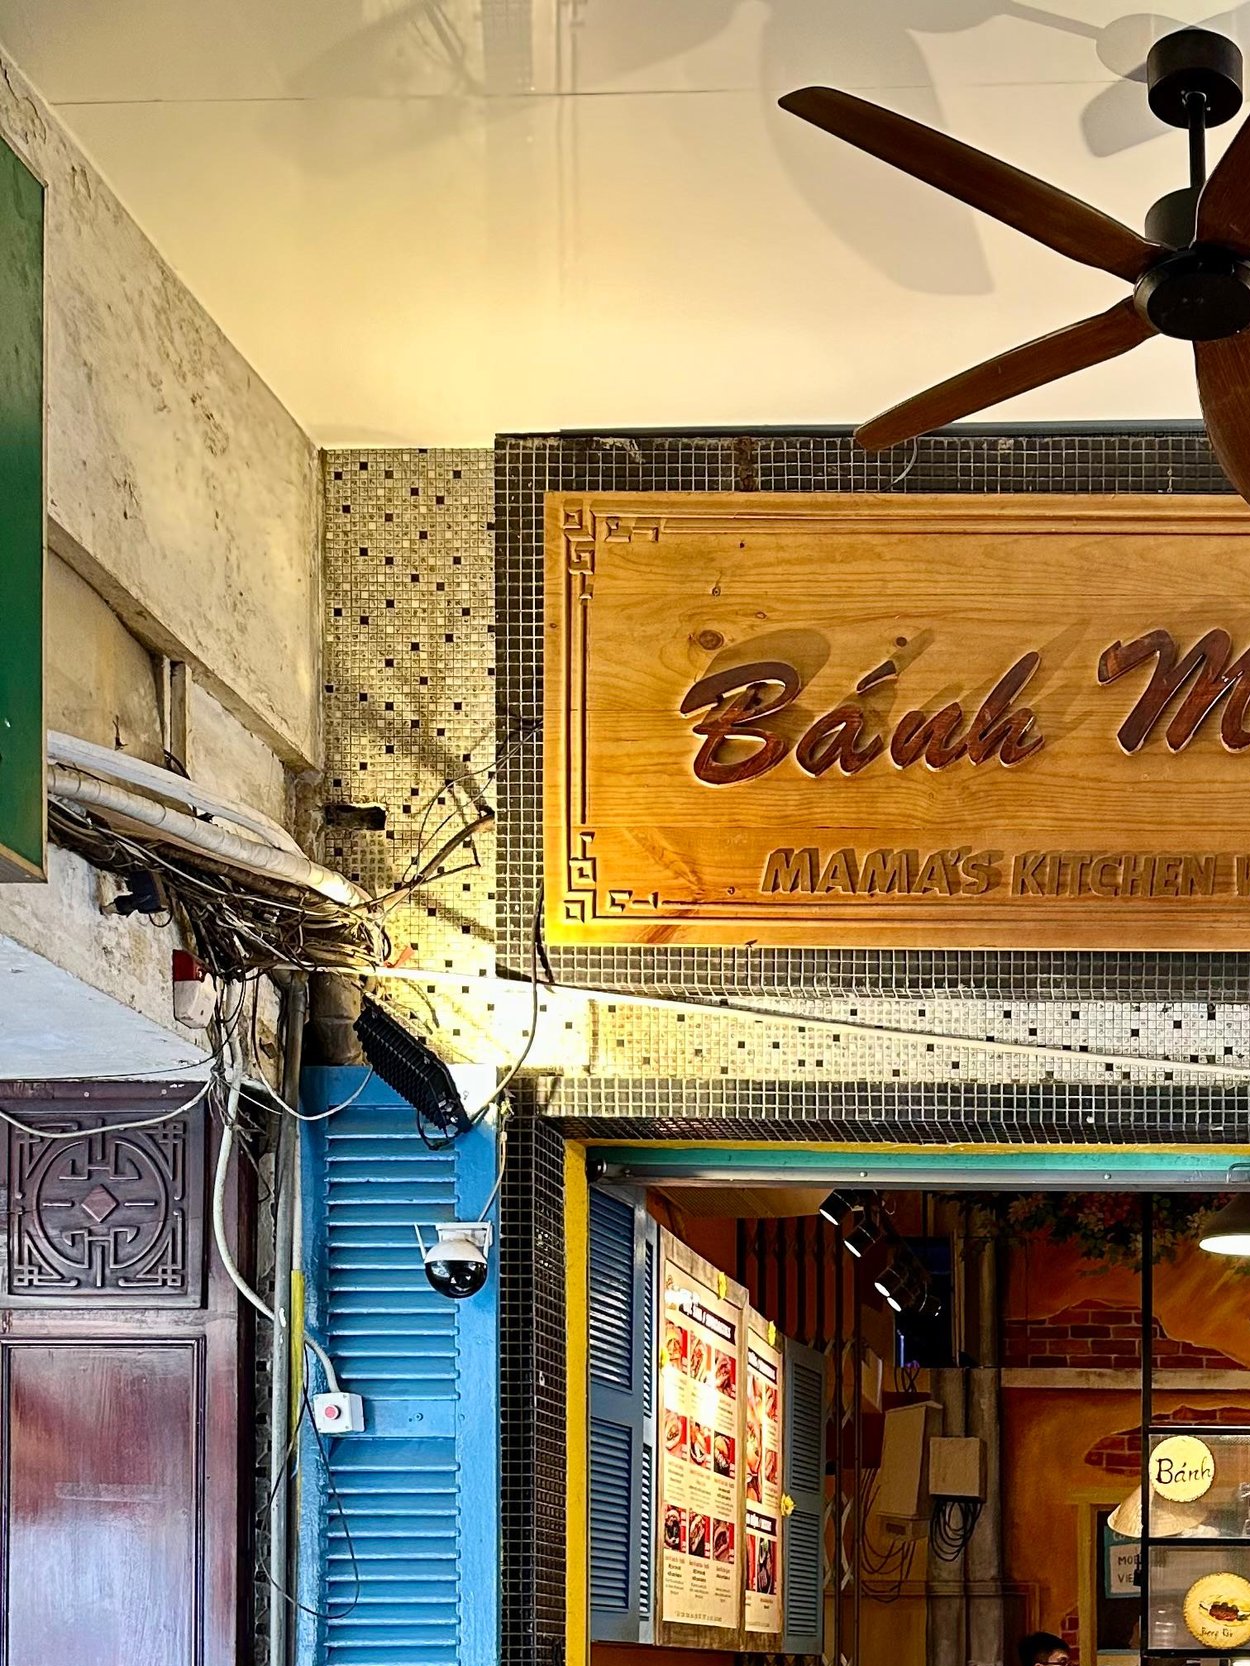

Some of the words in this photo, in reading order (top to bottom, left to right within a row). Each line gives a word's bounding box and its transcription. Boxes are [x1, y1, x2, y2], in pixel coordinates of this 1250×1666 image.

[680, 650, 1045, 788] Bánh
[760, 848, 996, 895] MAMA'S
[1011, 852, 1217, 896] KITCHEN
[1156, 1457, 1211, 1484] Bánh
